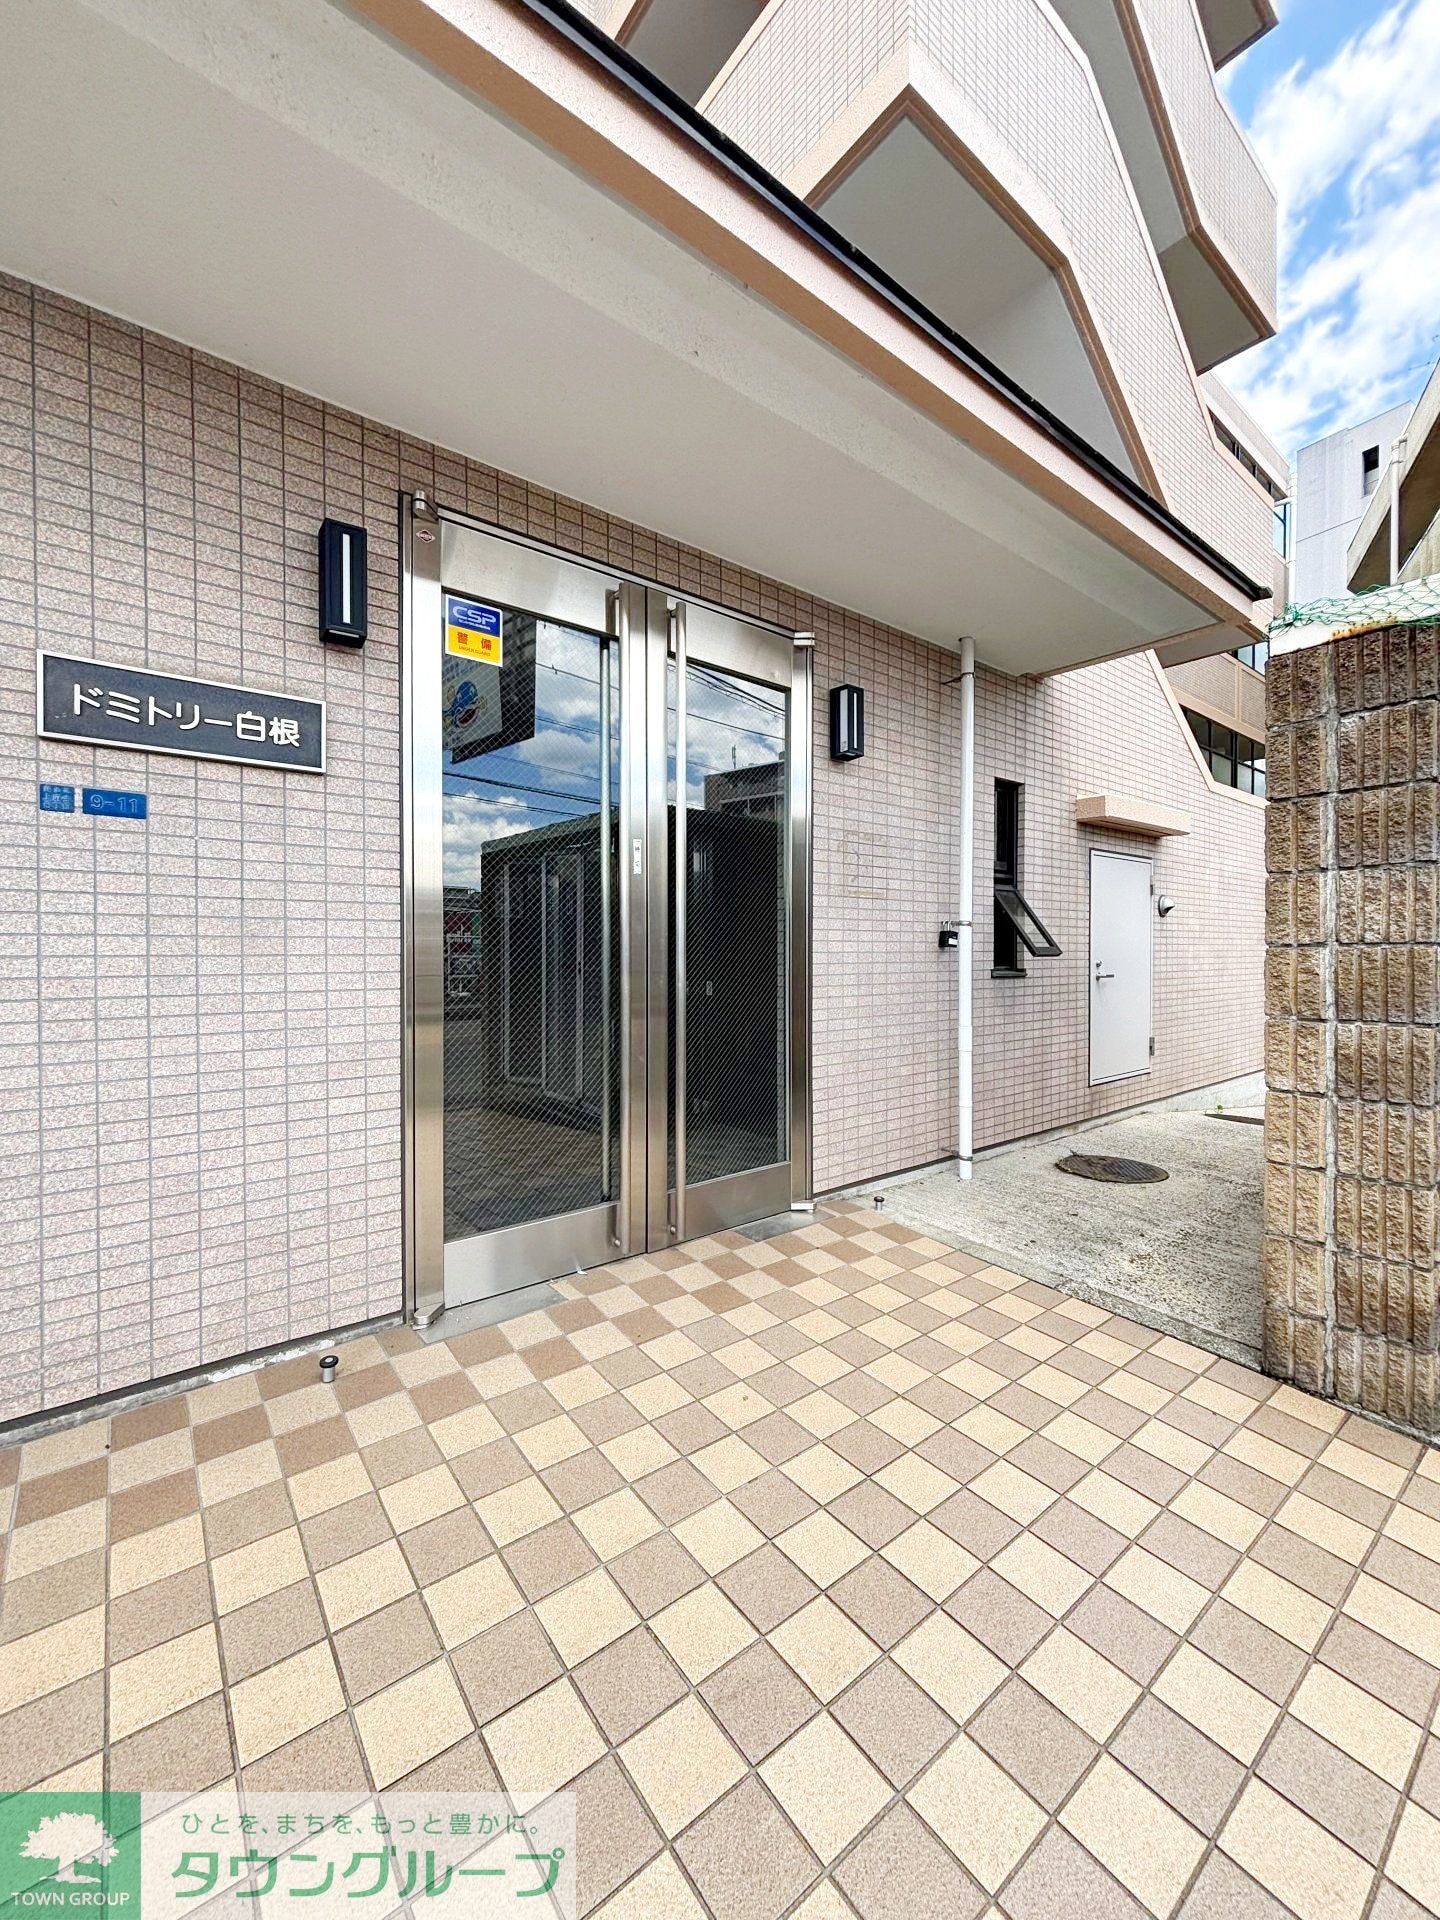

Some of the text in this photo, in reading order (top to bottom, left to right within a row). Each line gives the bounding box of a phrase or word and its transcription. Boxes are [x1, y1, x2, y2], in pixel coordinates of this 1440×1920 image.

[453, 606, 496, 625] CSP
[73, 683, 300, 747] ドミトリー白根
[90, 794, 138, 813] 9-11
